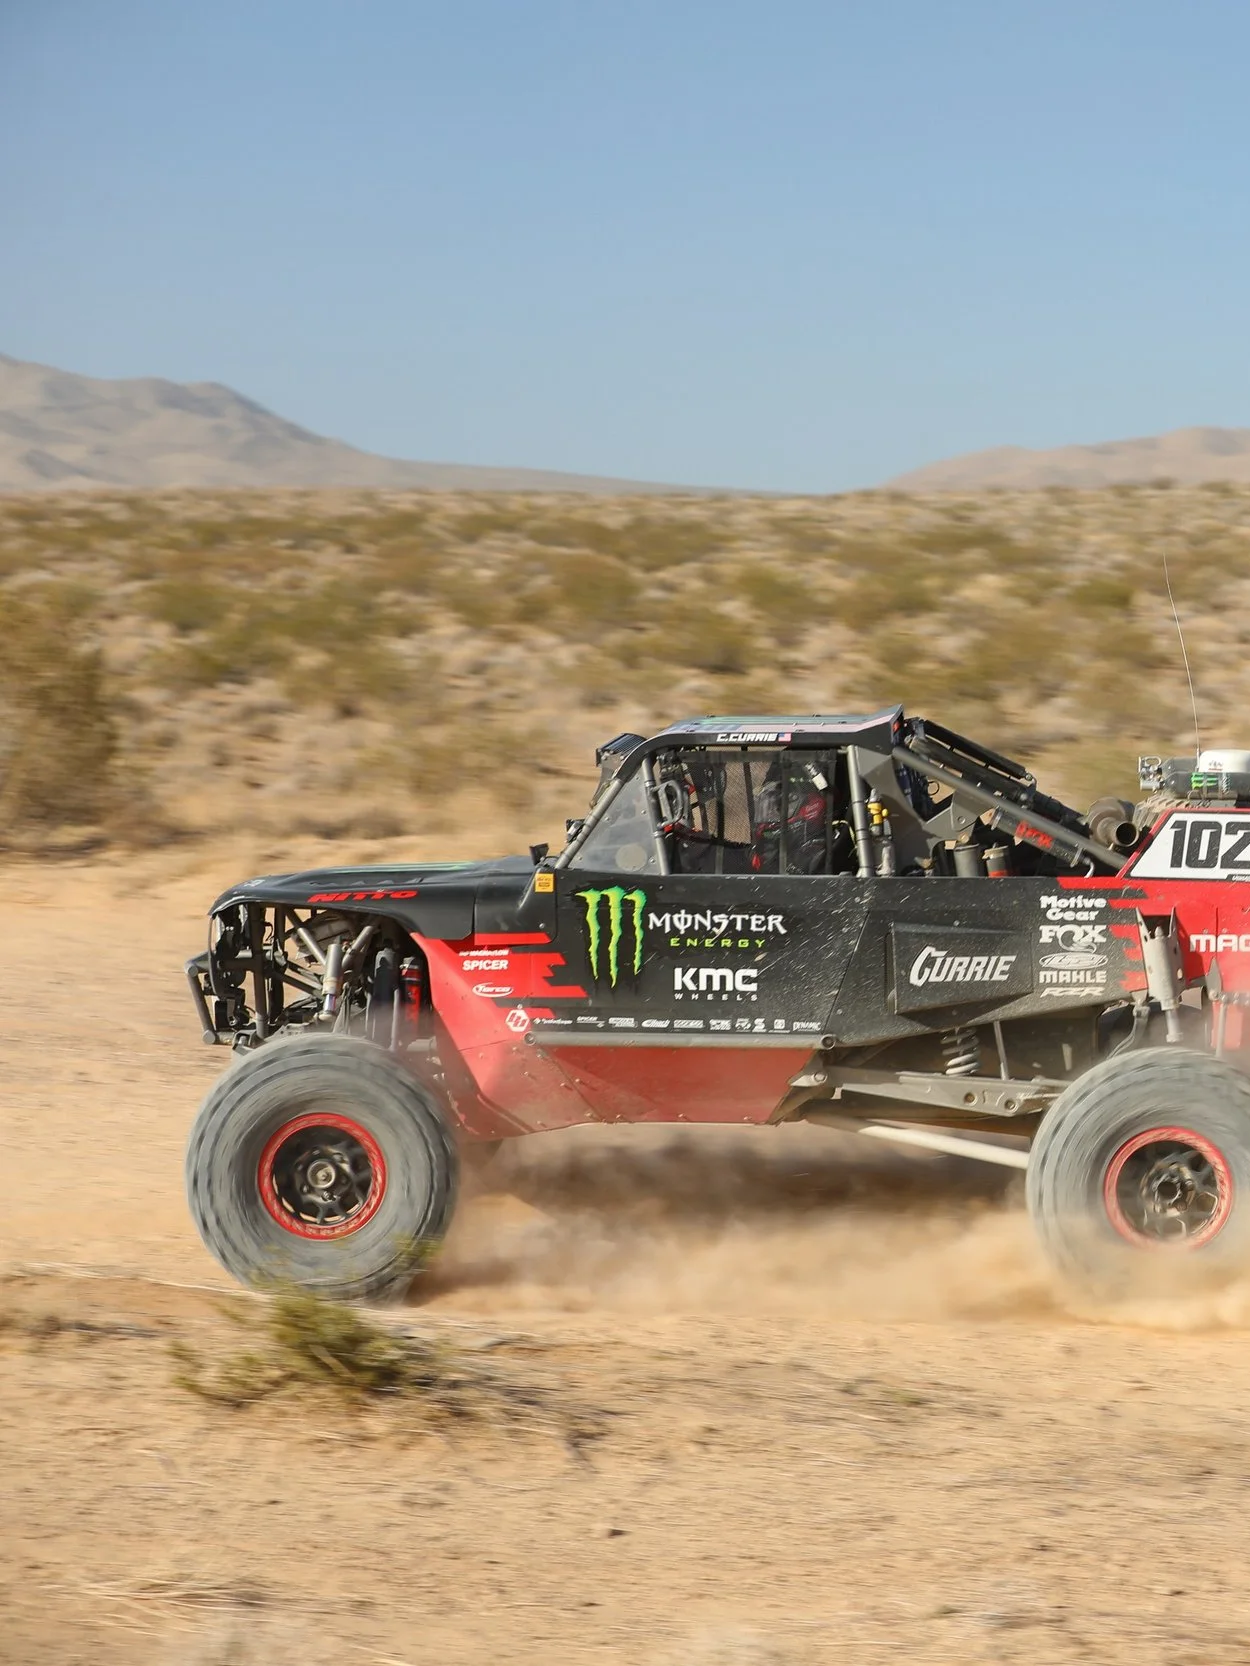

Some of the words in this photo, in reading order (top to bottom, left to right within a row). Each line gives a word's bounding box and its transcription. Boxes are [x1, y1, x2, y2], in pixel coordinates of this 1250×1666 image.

[307, 890, 418, 903] NITTO
[1040, 895, 1107, 908] Motive
[1046, 908, 1099, 921] Gear
[648, 909, 787, 938] MONSTER
[670, 937, 766, 948] ENERGY
[1039, 924, 1107, 950] FOX
[462, 960, 509, 971] SPICER
[909, 945, 1017, 987] CURRIE
[674, 967, 758, 992] KMC
[1039, 971, 1107, 983] MAHLE
[674, 993, 758, 1001] WHEELS
